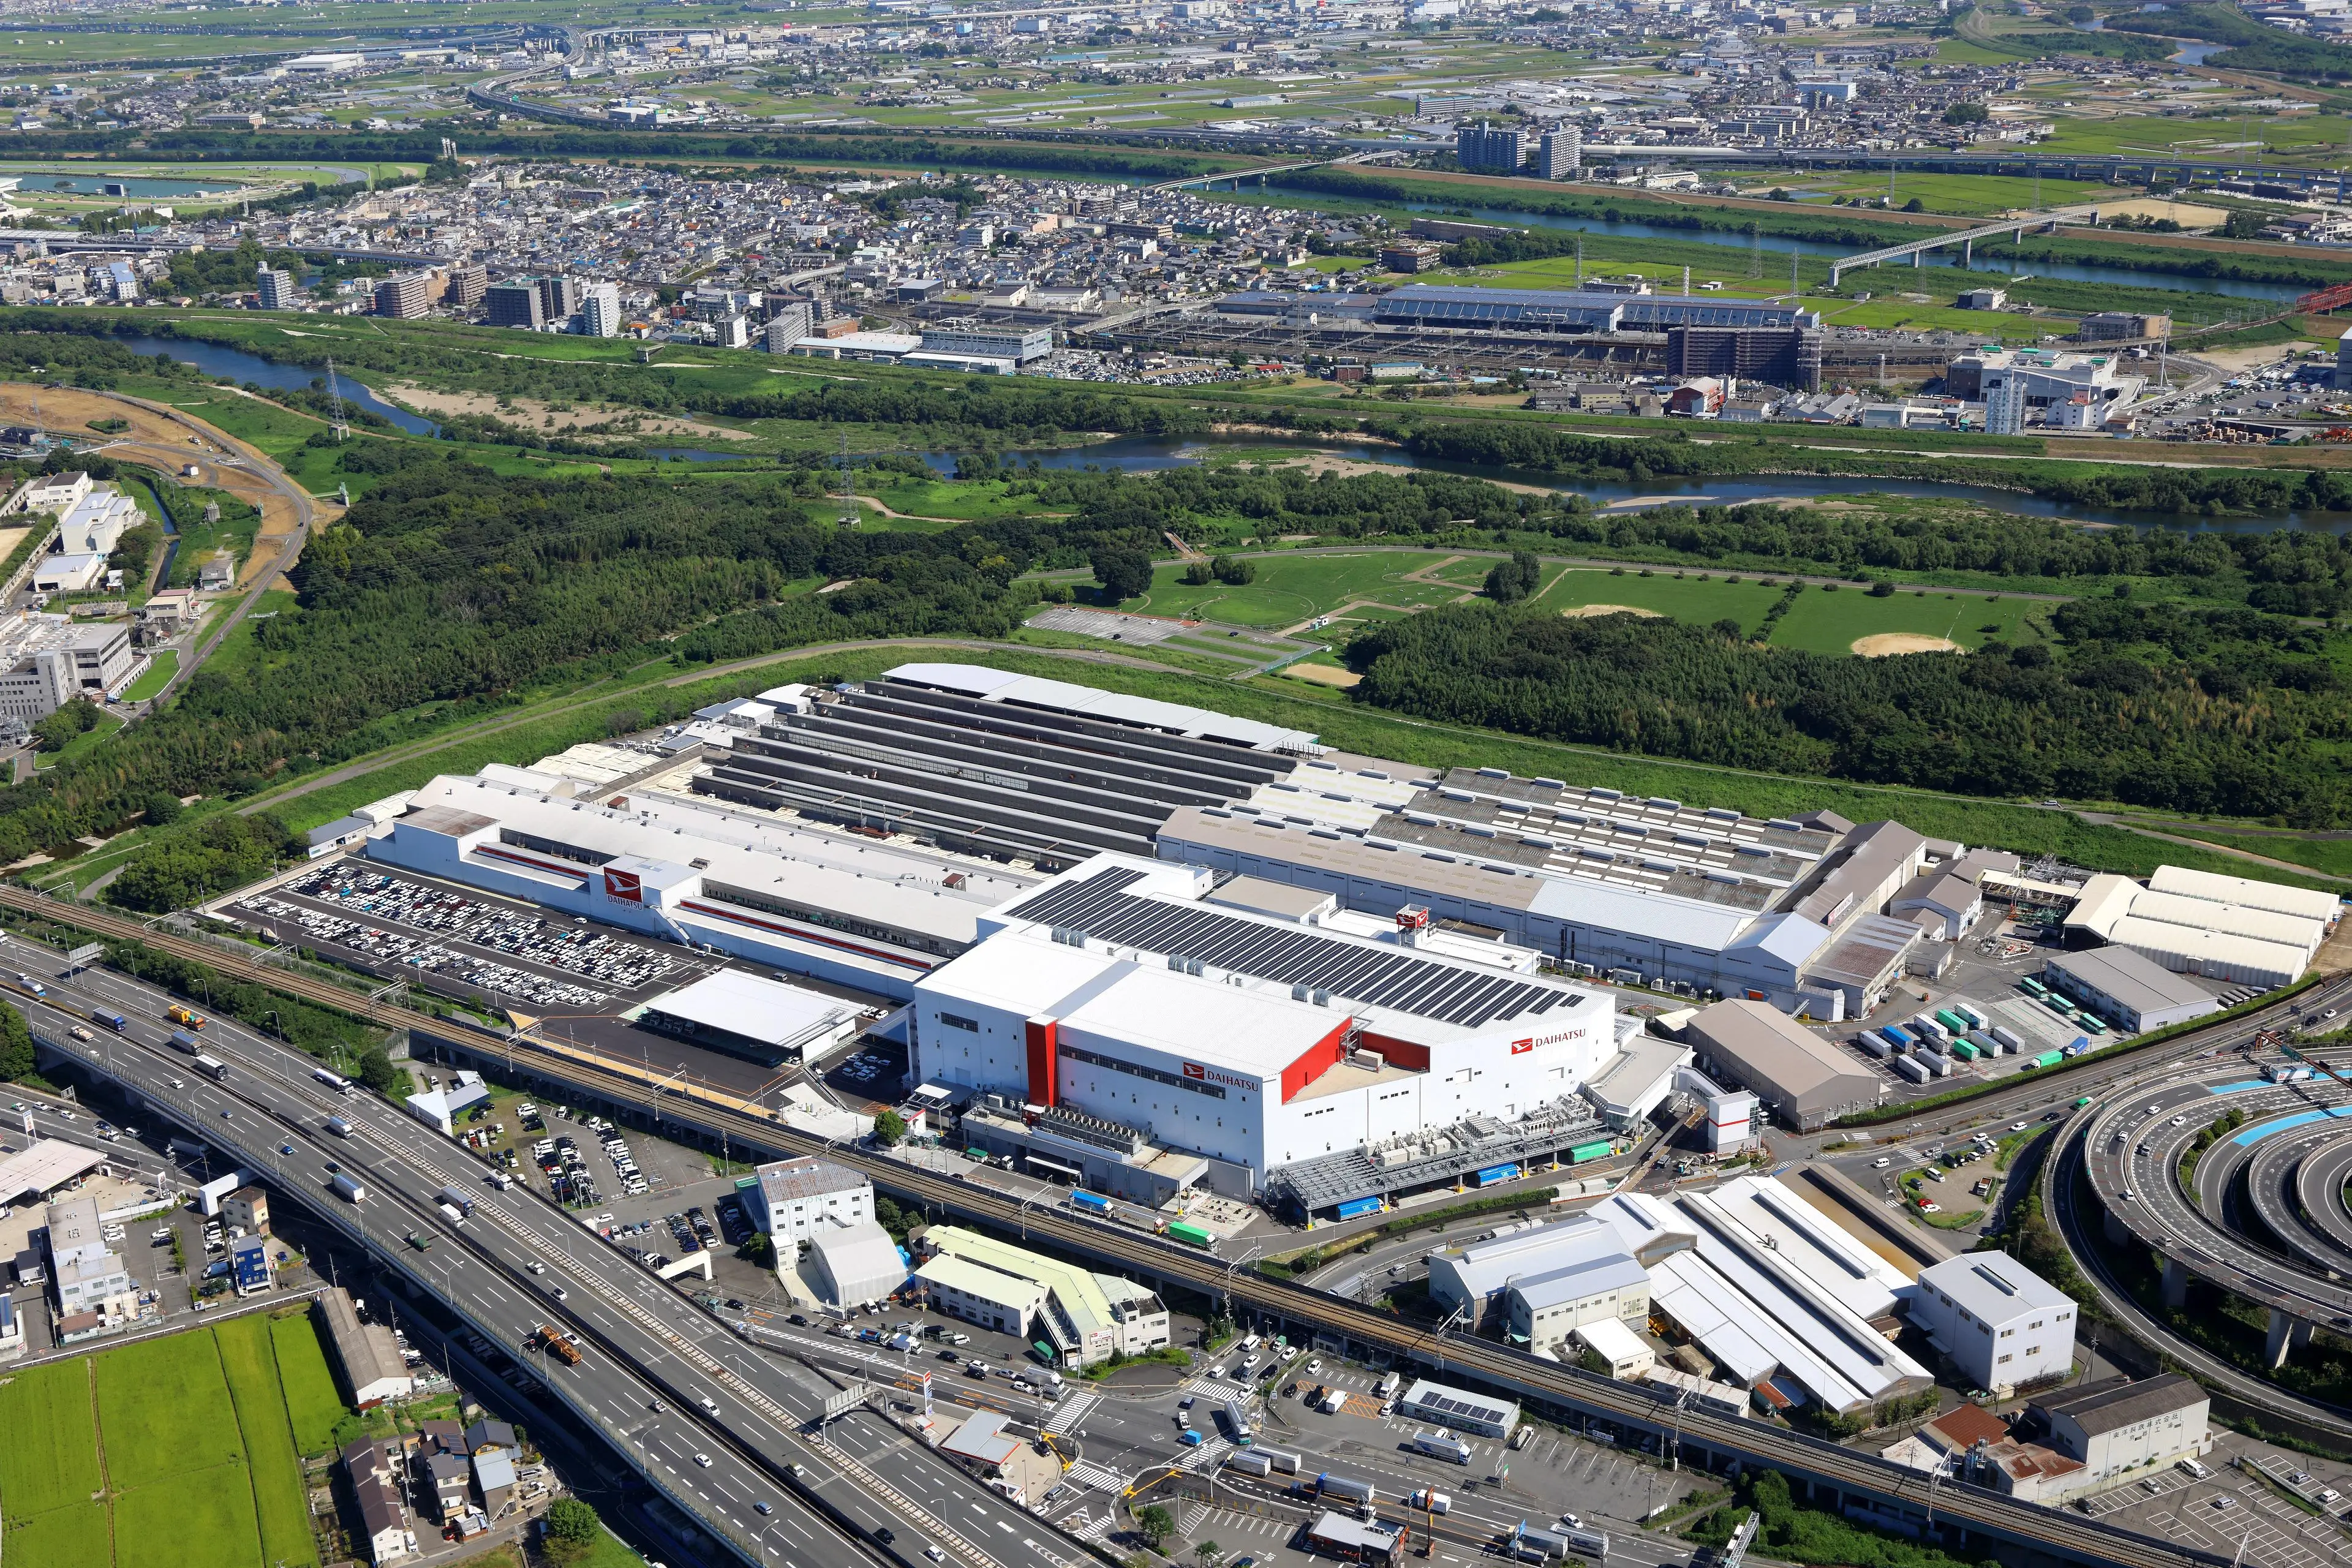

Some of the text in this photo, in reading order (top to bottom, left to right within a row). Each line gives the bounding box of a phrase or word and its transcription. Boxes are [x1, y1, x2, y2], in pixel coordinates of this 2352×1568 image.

[608, 895, 643, 911] DAIHATSU
[1536, 1028, 1586, 1047] DAIHATSU
[1207, 1070, 1259, 1093] DAIHATSU
[782, 1194, 830, 1208] TOYONO
[1264, 1552, 1276, 1562] OUT
